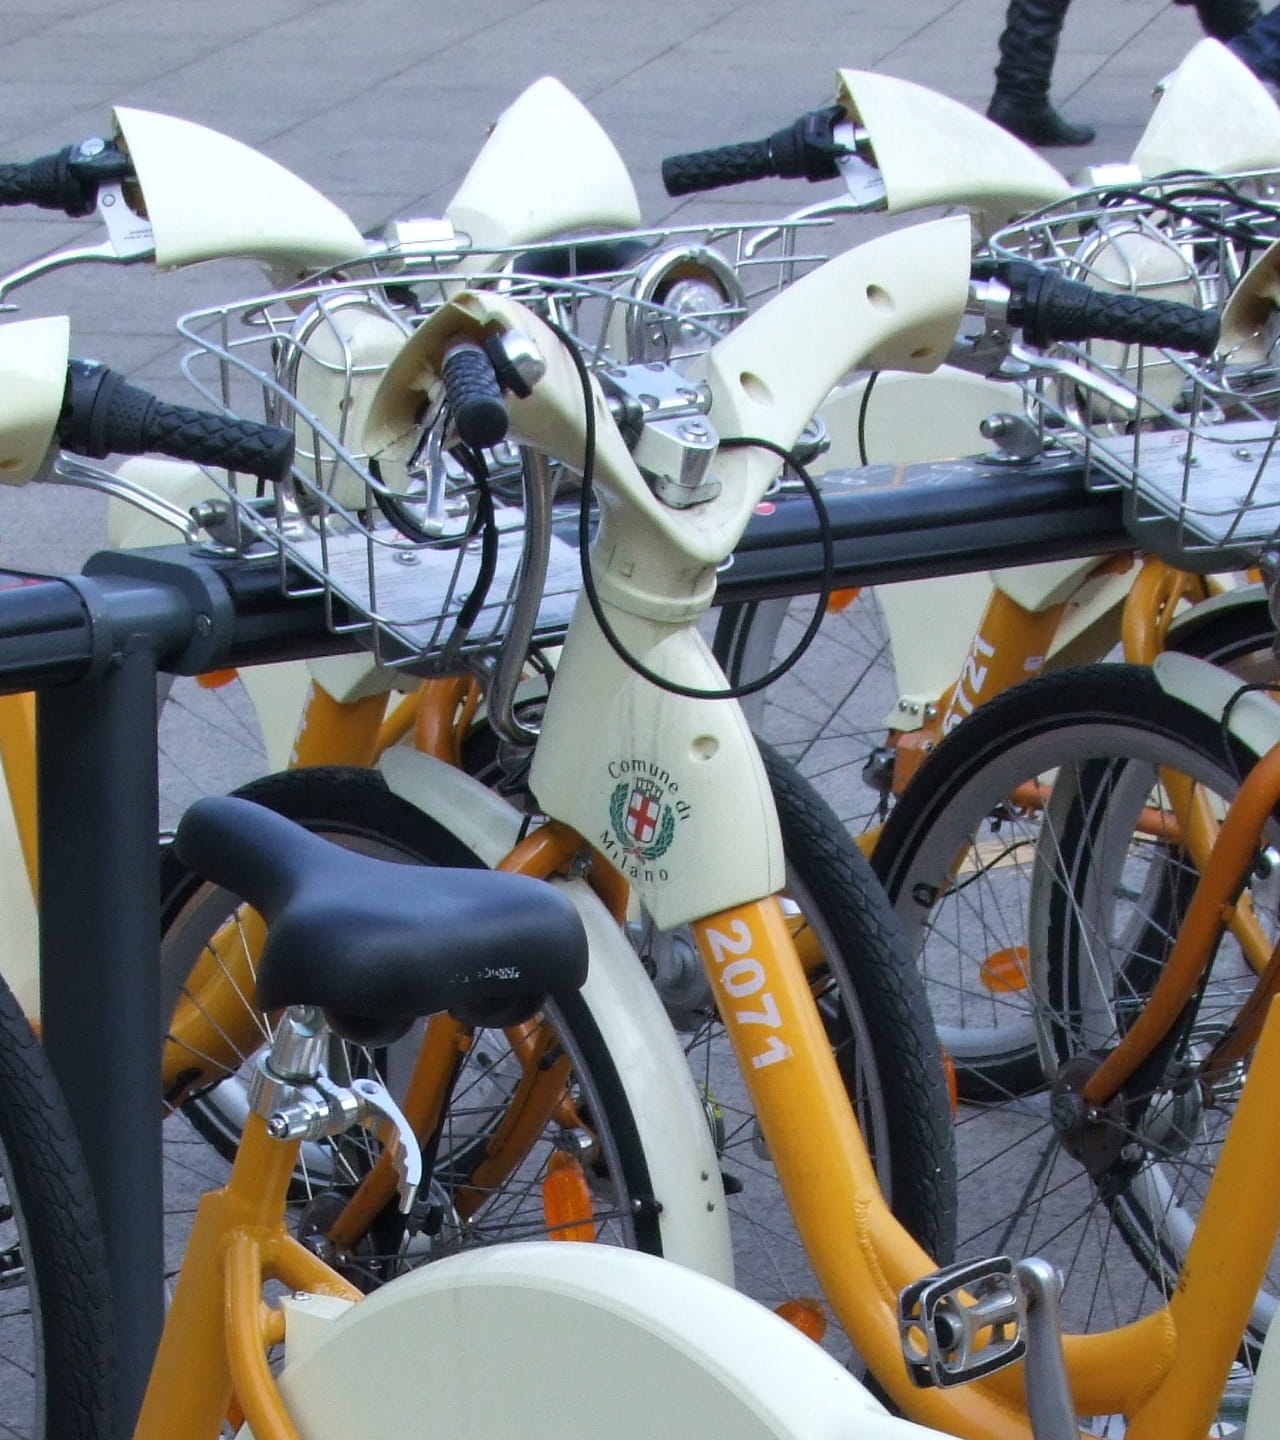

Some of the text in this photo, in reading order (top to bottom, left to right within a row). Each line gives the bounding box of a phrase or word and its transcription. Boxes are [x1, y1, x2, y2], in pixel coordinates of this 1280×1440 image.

[608, 759, 691, 821] Comune di
[601, 830, 669, 882] Milano
[704, 919, 795, 1070] 2071
